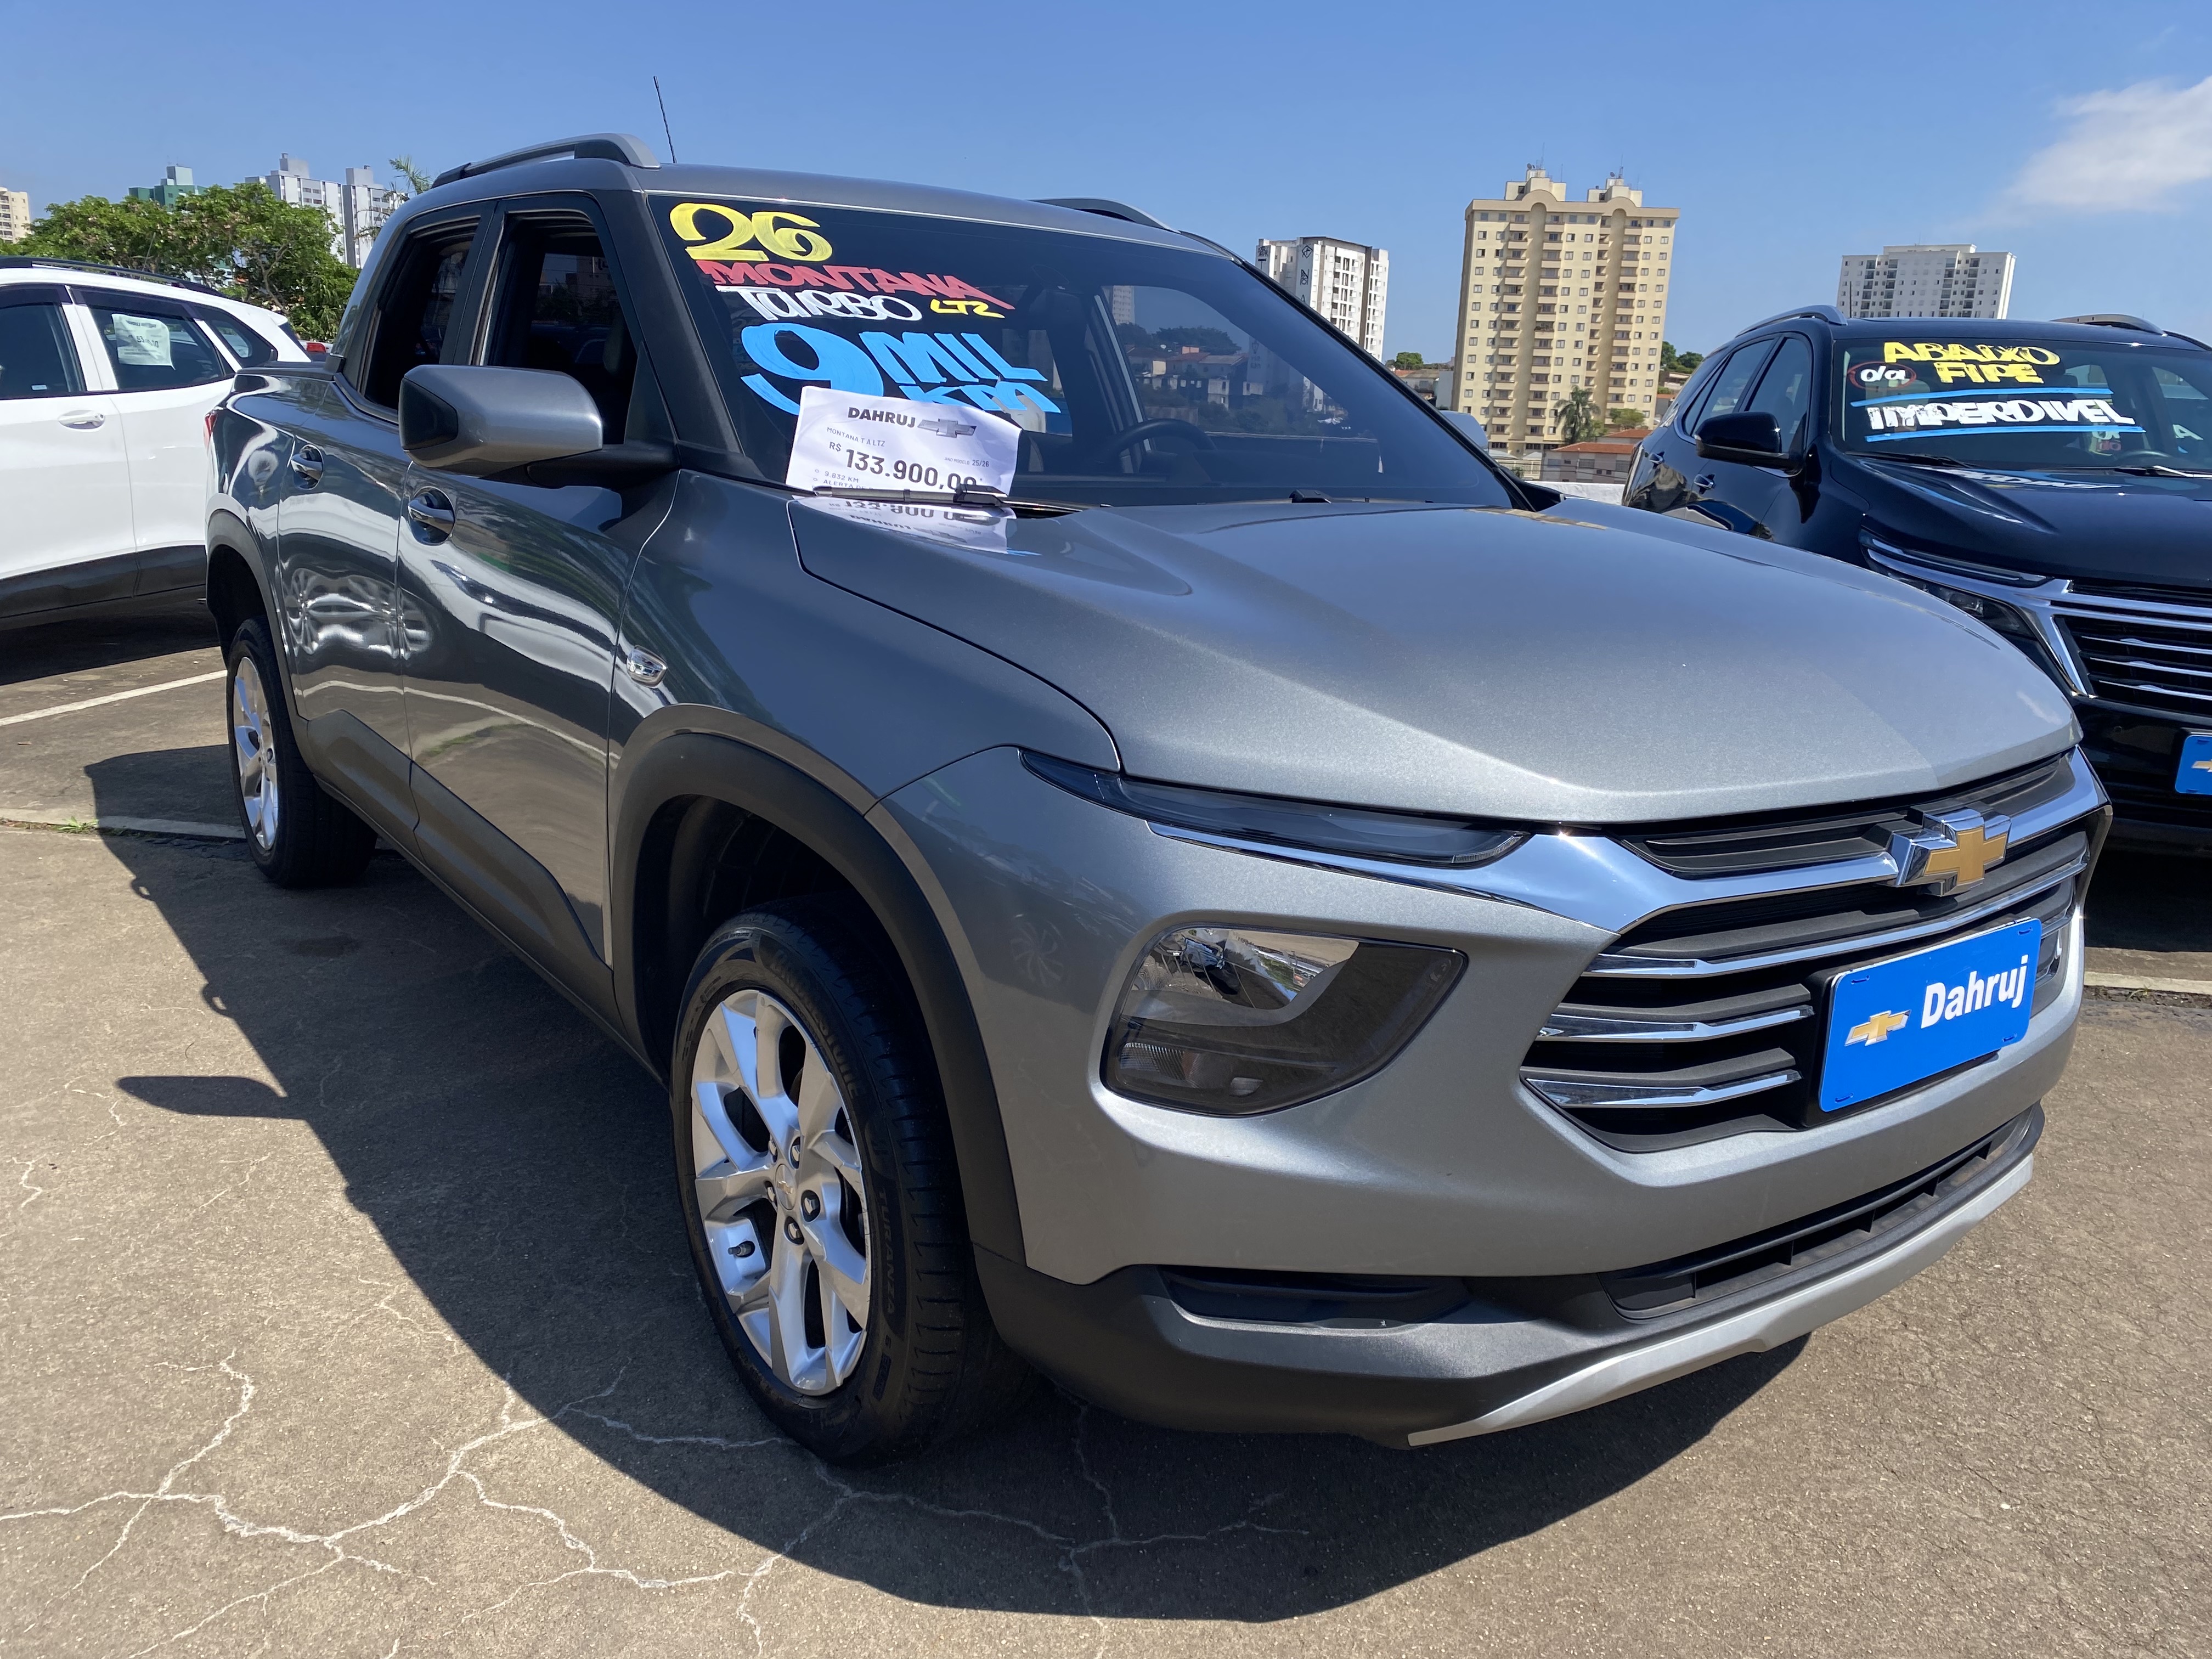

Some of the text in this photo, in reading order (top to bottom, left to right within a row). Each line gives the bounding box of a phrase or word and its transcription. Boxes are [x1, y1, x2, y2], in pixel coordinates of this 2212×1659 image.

[669, 202, 833, 262] 26
[695, 259, 1015, 310] MONTANA
[715, 285, 922, 321] TURBO
[1883, 341, 2061, 365] ABAIXO
[740, 323, 1048, 416] 9 MIL
[1933, 362, 2044, 383] FIPE
[848, 407, 916, 428] DAHRUJ
[1866, 399, 2135, 430] IMPERDIVEL
[827, 427, 859, 442] MONTANA
[829, 441, 842, 452] R$
[972, 459, 990, 467] 25/26
[823, 479, 854, 489] ALERTA
[825, 471, 846, 481] 9.832
[1921, 954, 2029, 1029] Dahruj
[878, 1187, 895, 1316] TURANZA
